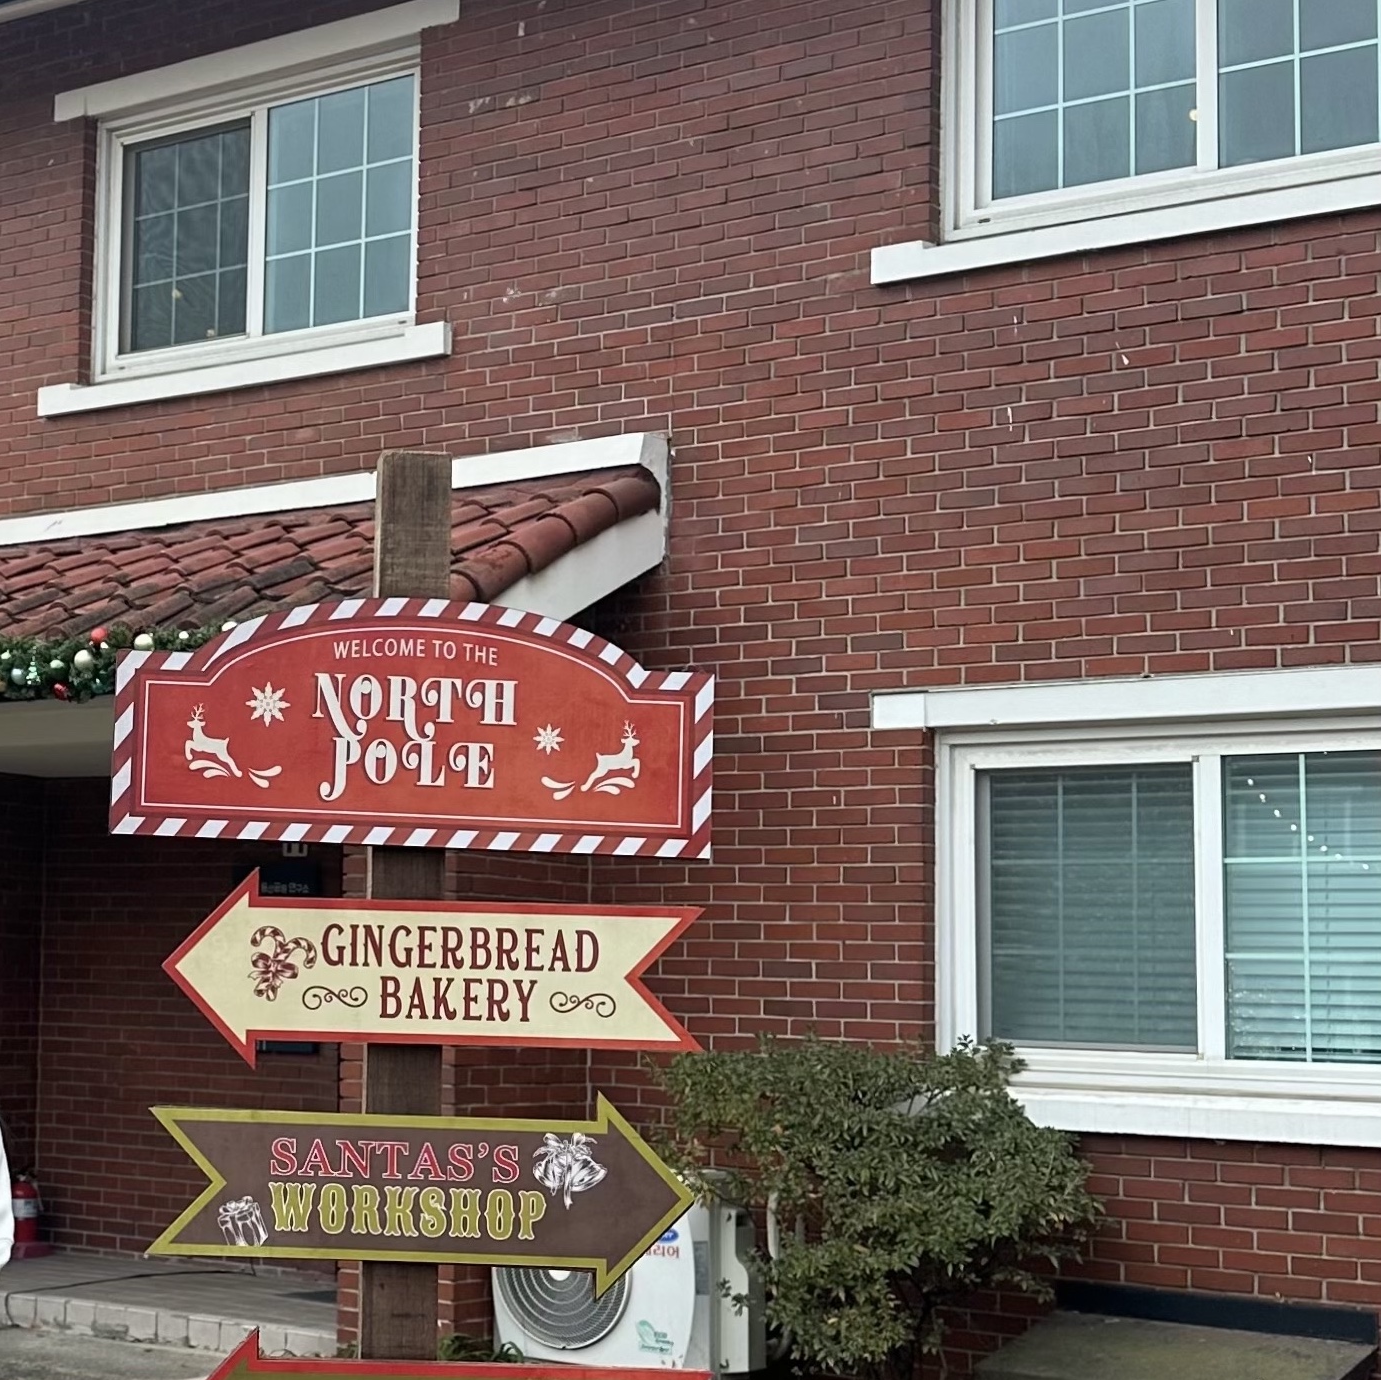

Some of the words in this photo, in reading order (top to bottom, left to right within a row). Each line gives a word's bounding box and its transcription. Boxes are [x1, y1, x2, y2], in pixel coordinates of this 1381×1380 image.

[333, 639, 425, 660] WELCOME
[433, 640, 457, 661] TO
[463, 643, 498, 666] THE
[312, 672, 518, 743] NORTH
[320, 737, 495, 801] POLE
[321, 923, 600, 973] GINGERBREAD
[378, 976, 539, 1023] BAKERY
[269, 1137, 521, 1183] SANTAS'S
[268, 1181, 547, 1241] WORKSHOP
